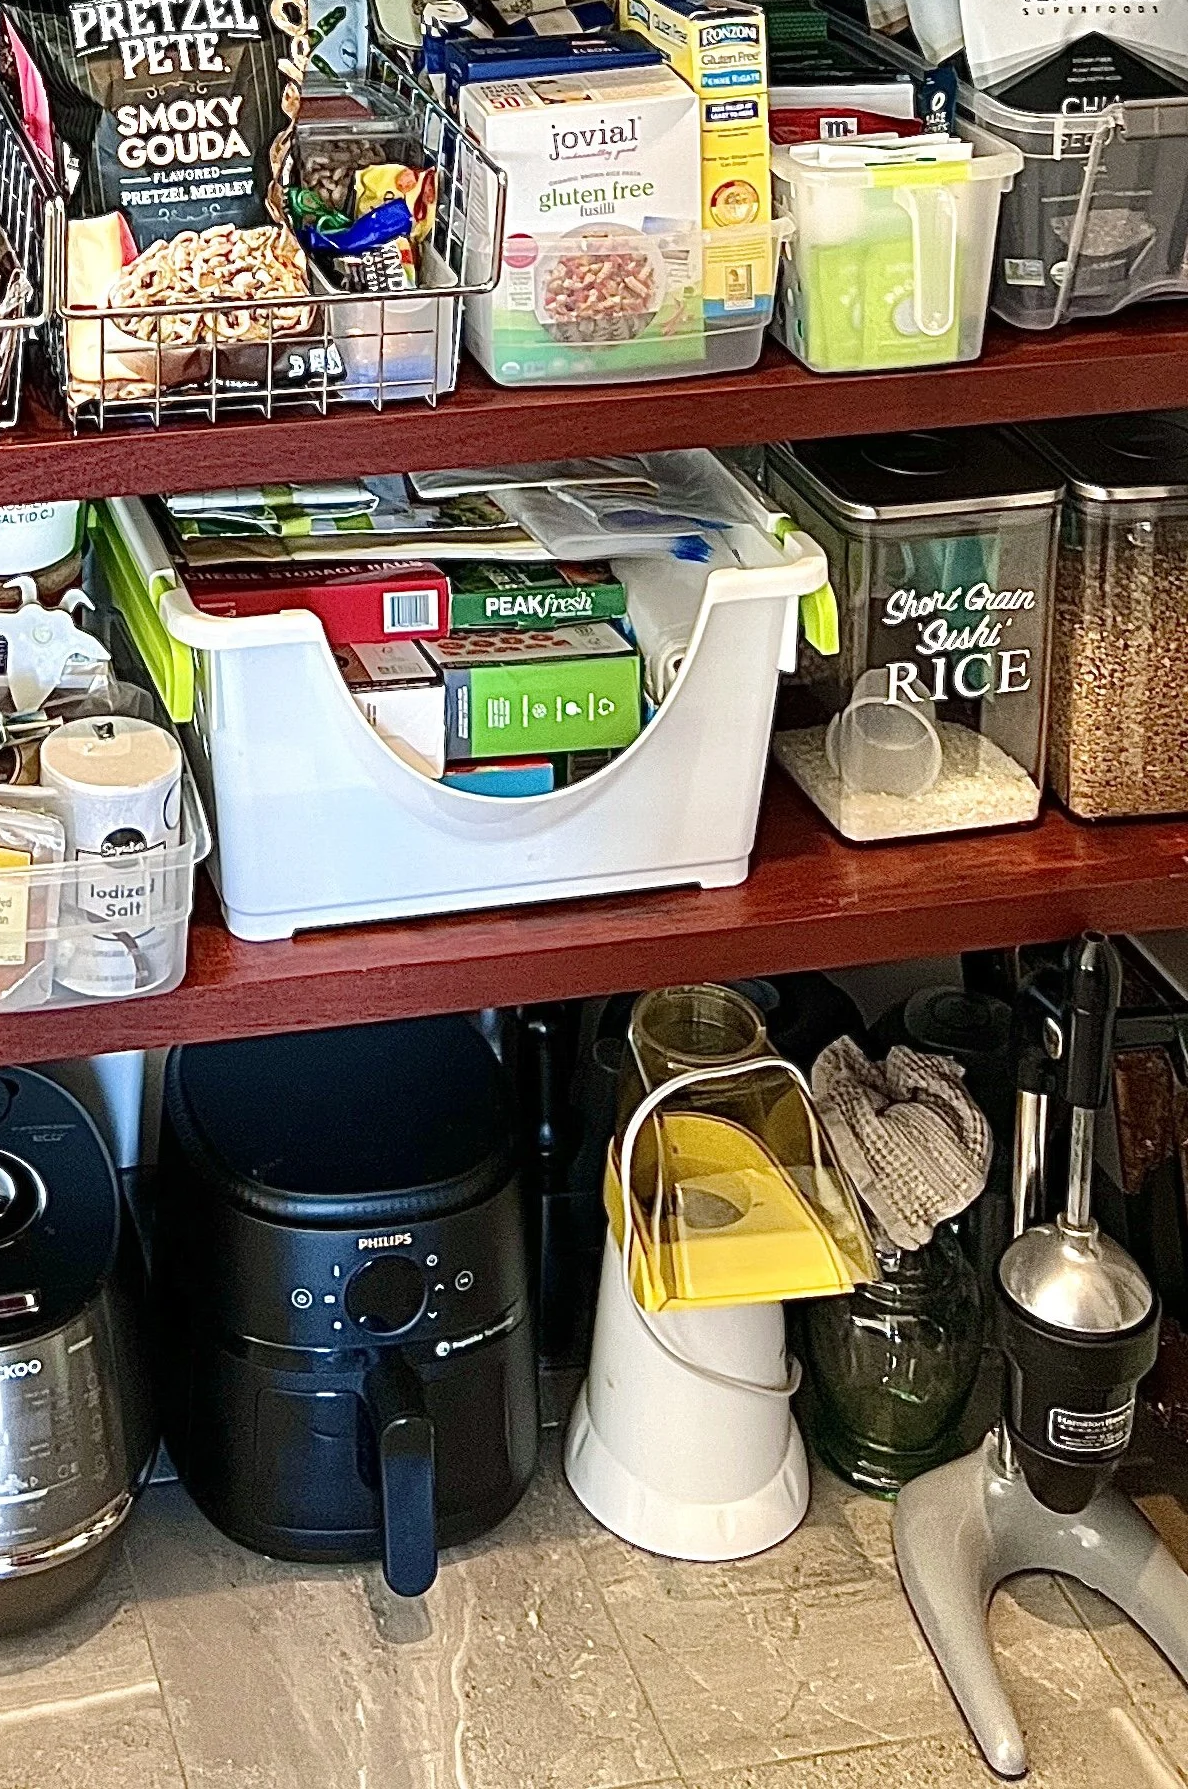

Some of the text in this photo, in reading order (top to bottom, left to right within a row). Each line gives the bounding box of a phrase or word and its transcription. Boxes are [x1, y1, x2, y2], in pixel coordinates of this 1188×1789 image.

[1022, 5, 1159, 15] SUPERFOODS
[702, 23, 756, 46] RONZONI
[701, 51, 760, 65] Gluten Free
[702, 71, 761, 86] PENNE RIGATE
[490, 96, 522, 110] 50
[116, 95, 244, 137] SMOKY
[117, 126, 251, 169] GOUDA
[549, 119, 639, 161] jovial
[152, 166, 220, 184] FLAVORED
[120, 180, 254, 206] PRETZEL MEDLEY
[539, 180, 654, 213] gluten free
[580, 202, 615, 217] fusilli
[278, 564, 364, 579] STORAGE
[882, 582, 1035, 627] Short Grain
[884, 649, 1031, 706] RICE
[105, 902, 141, 917] Salt
[358, 1232, 412, 1250] PHILIPS
